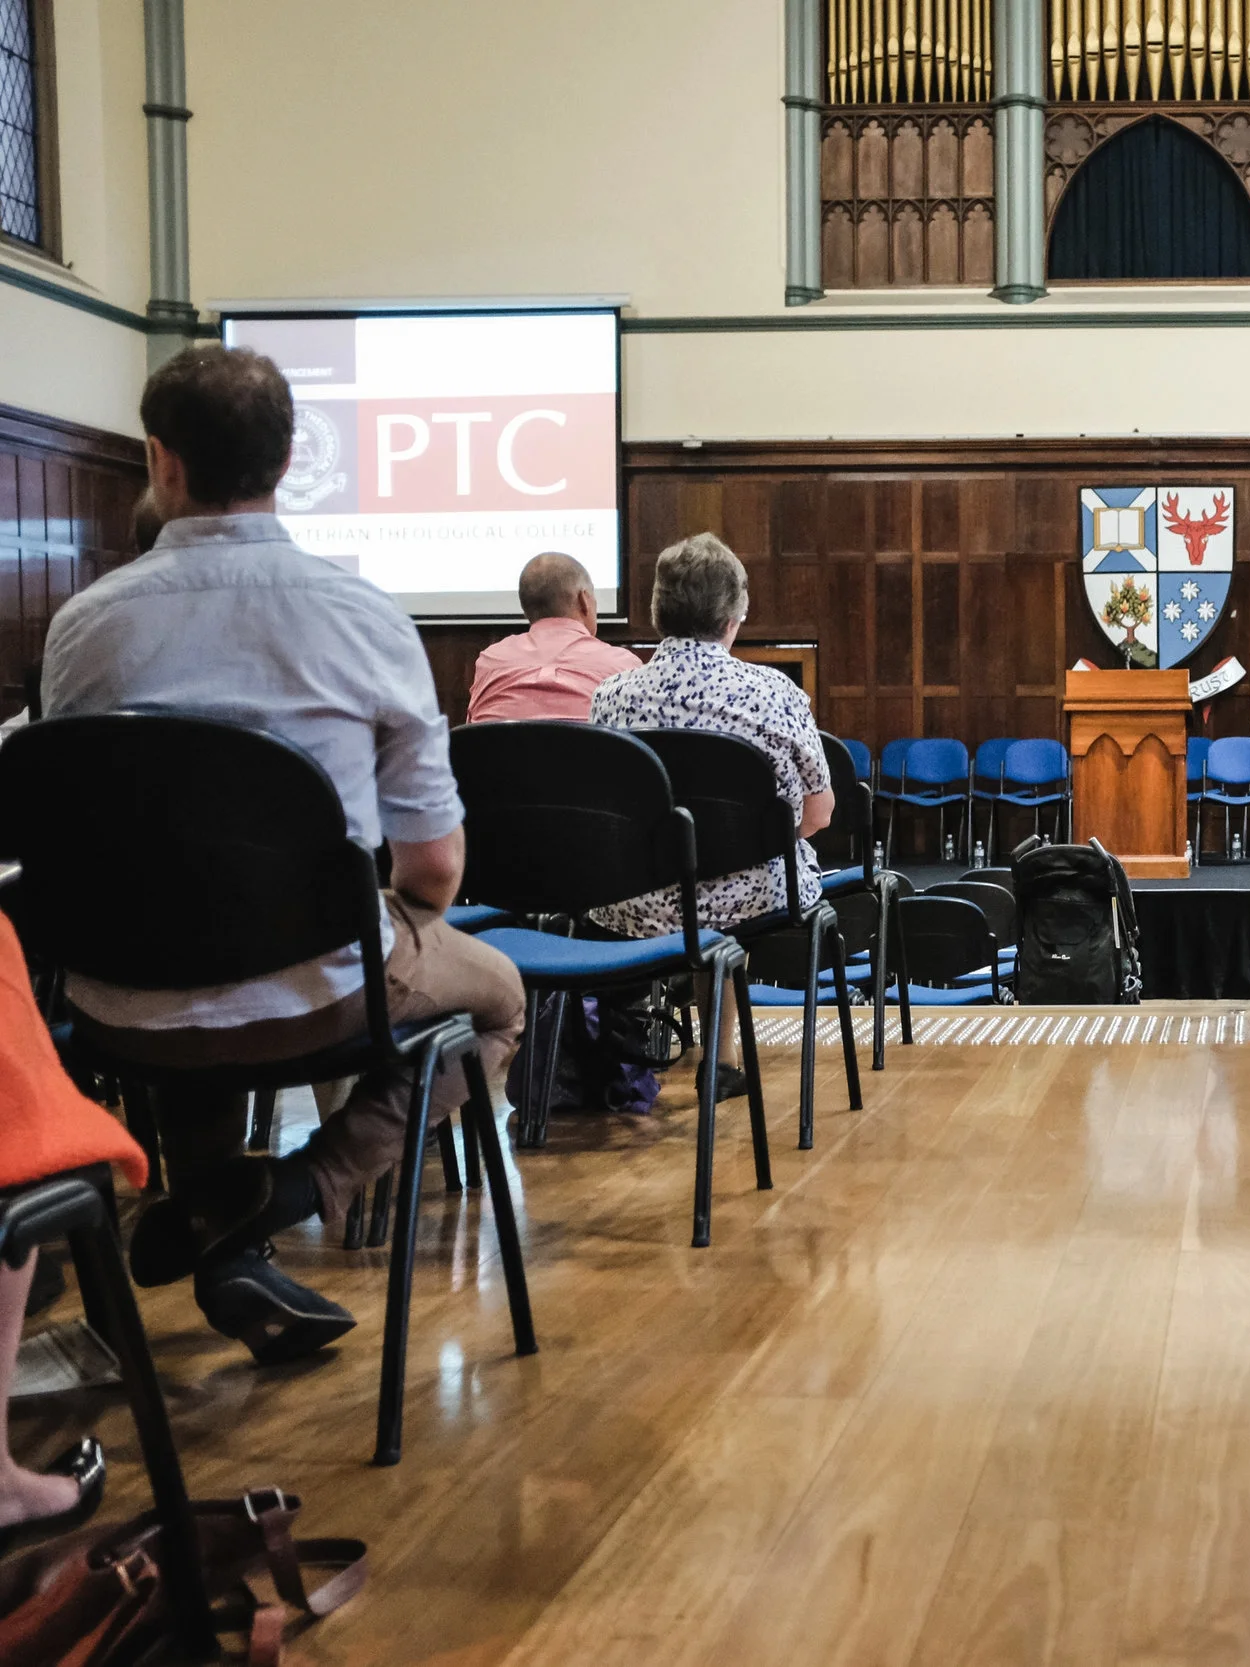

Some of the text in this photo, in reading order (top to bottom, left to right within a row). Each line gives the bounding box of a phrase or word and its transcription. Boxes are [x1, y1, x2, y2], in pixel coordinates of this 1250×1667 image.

[376, 409, 567, 498] PTC
[294, 523, 597, 541] YTERIAN THEOLOGICAL COLLEGE
